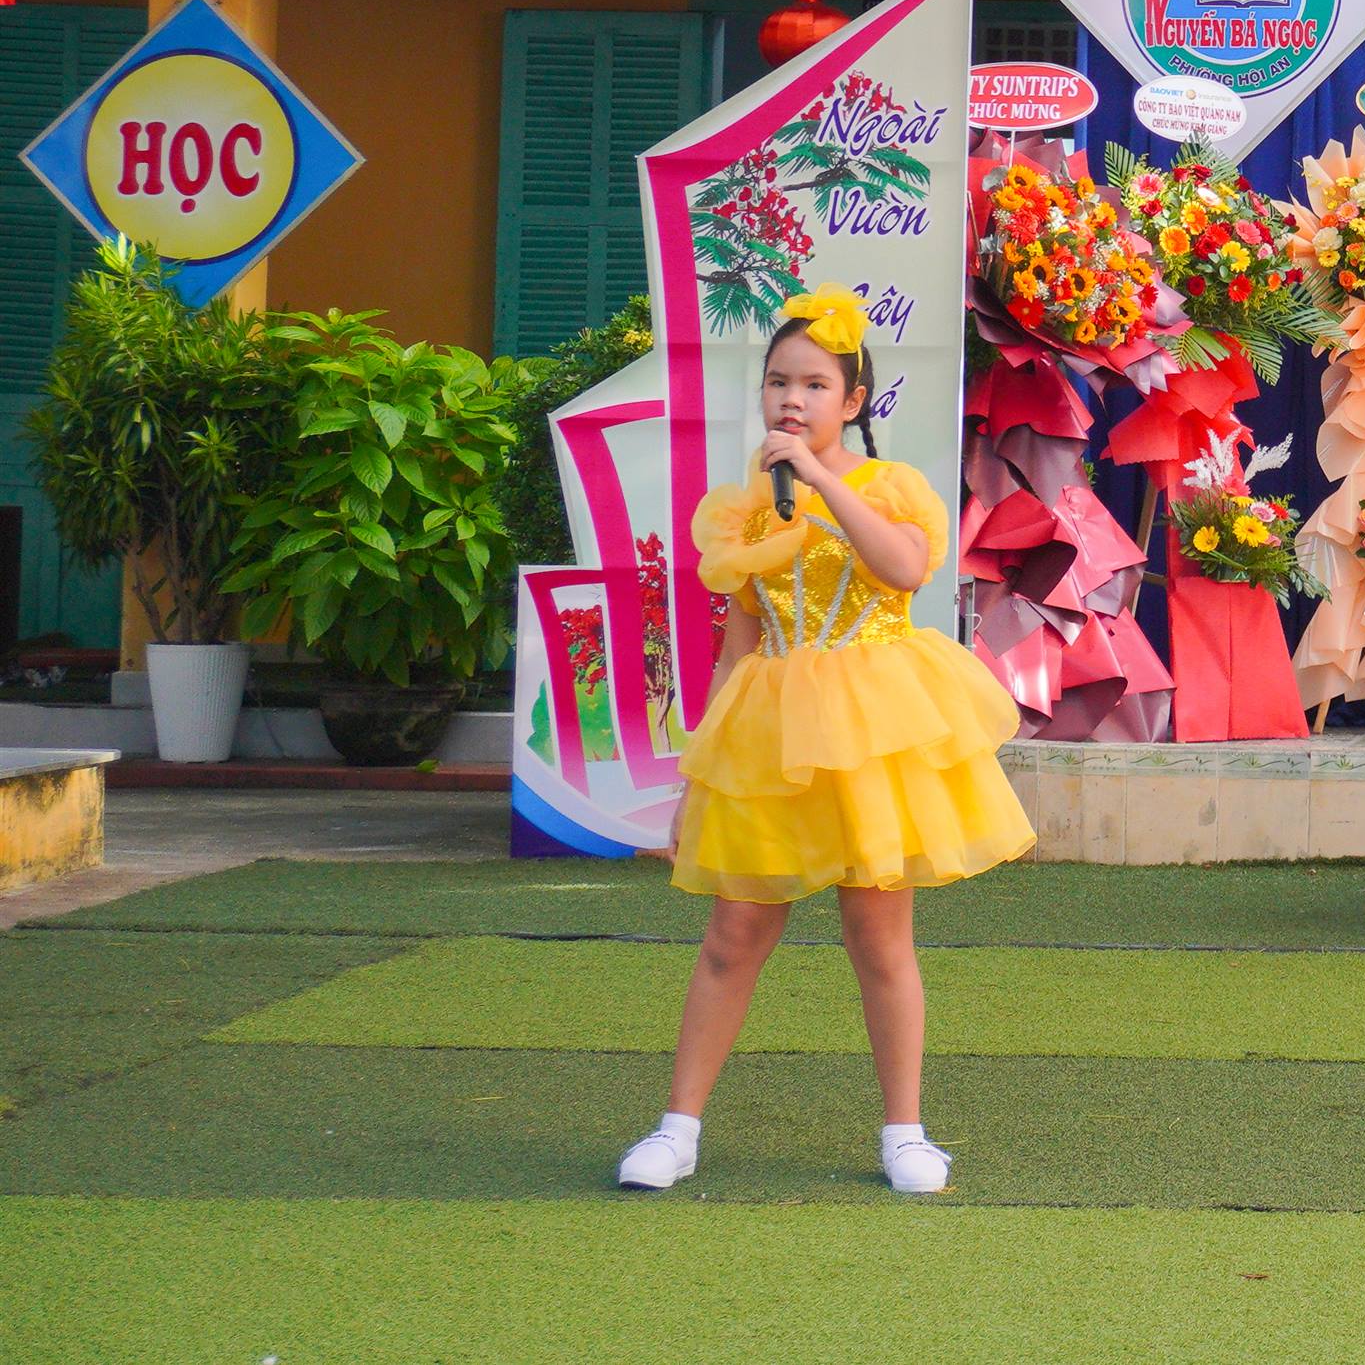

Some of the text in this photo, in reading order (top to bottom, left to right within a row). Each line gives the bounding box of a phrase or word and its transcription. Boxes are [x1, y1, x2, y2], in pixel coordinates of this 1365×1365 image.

[1231, 12, 1257, 47] BÁ
[1263, 19, 1317, 54] NGỌC
[991, 75, 1079, 97] SUNTRIPS
[1170, 56, 1291, 87] PHƯỜNG HỘI AN
[816, 100, 947, 155] Ngoài
[968, 99, 1062, 119] CHÚC MỪNG
[117, 121, 262, 213] HỌC
[827, 186, 931, 236] Vườn
[871, 376, 904, 419] á
